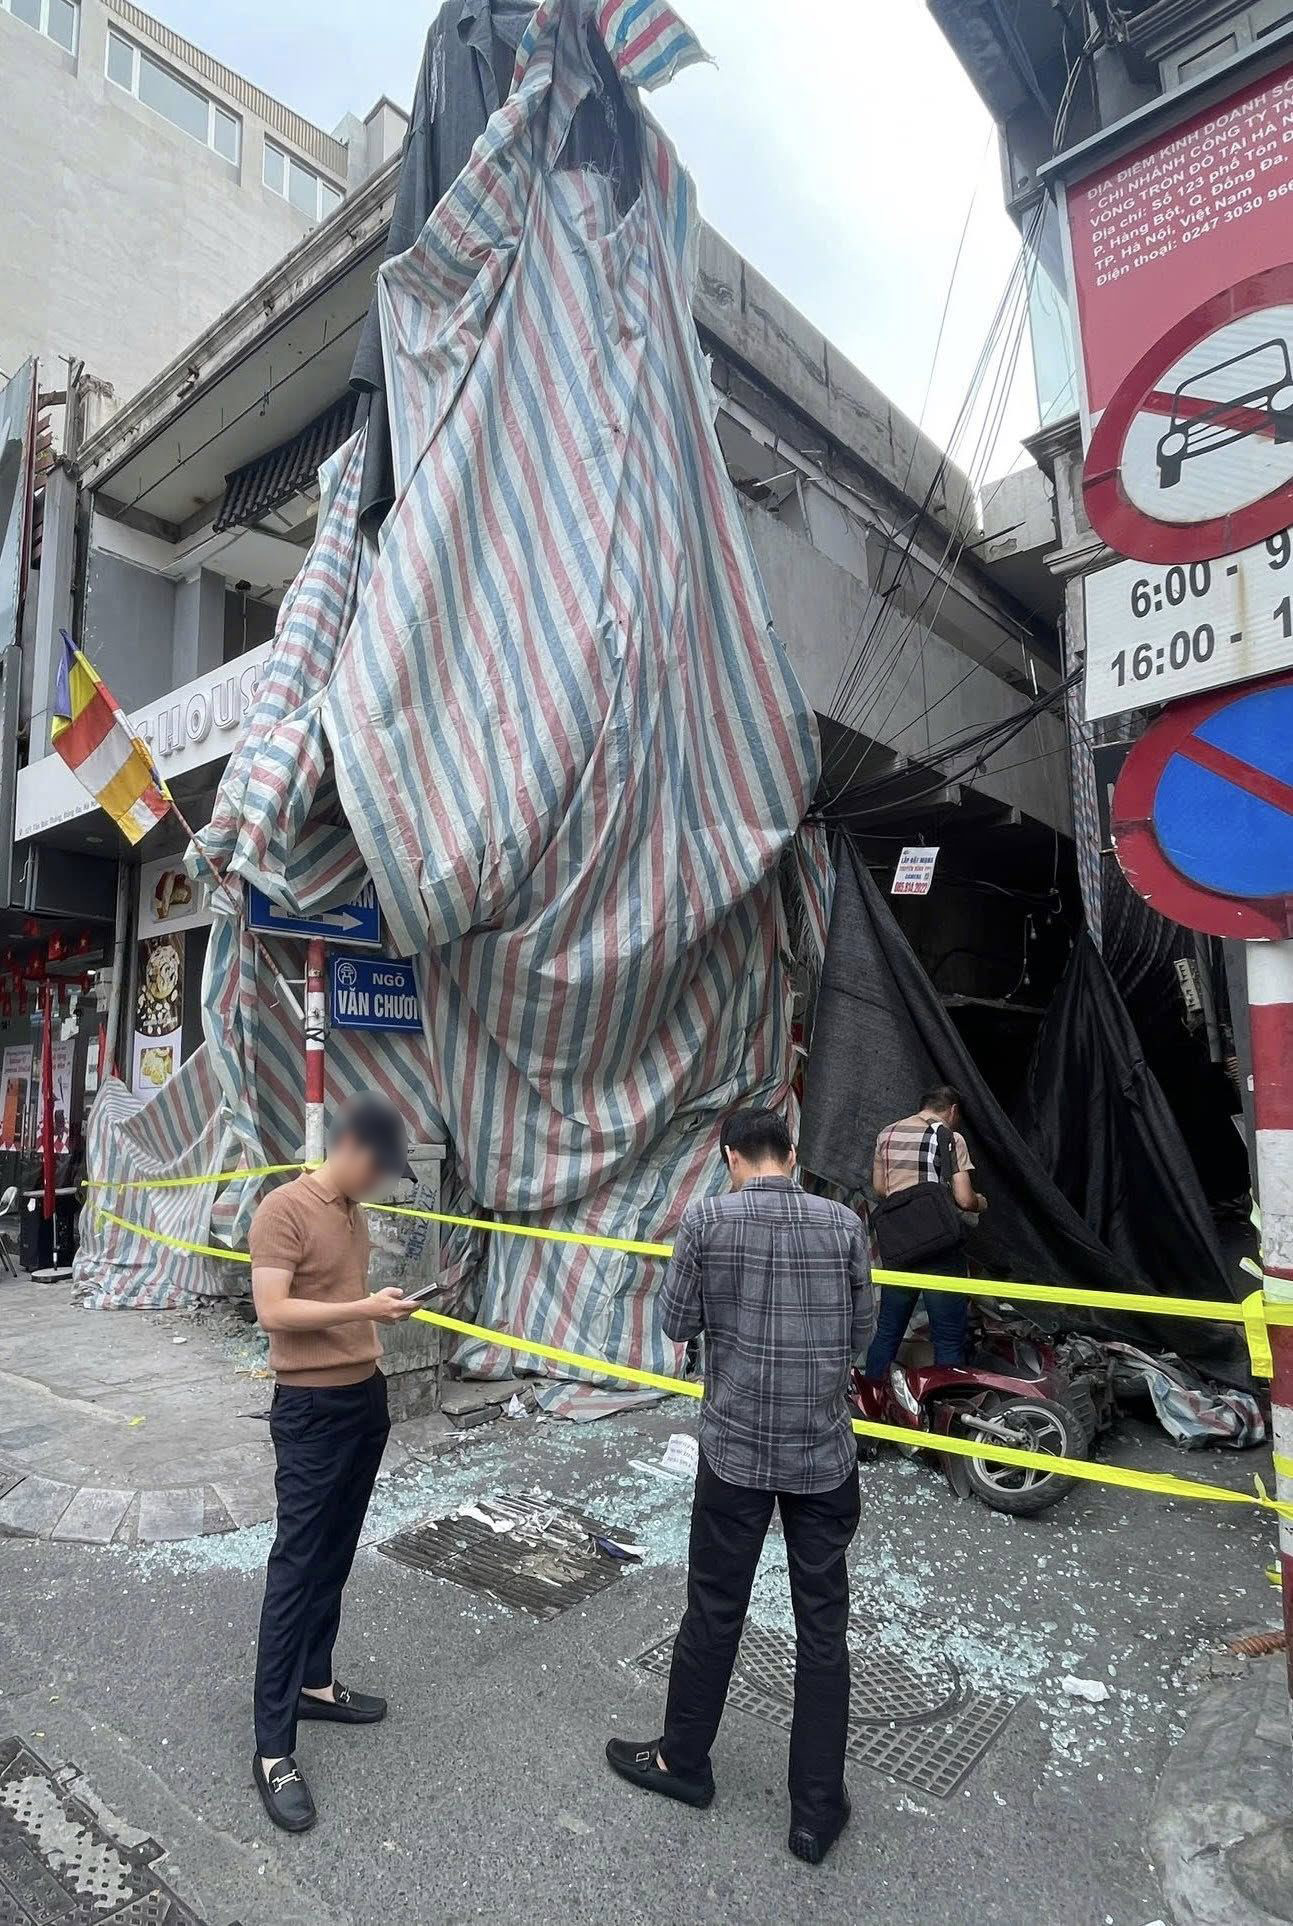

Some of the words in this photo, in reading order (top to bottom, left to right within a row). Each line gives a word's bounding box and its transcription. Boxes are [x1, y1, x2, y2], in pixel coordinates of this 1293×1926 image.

[1087, 179, 1113, 201] ĐỊA
[1161, 130, 1199, 159] KINH
[1204, 95, 1267, 135] DOANH
[1092, 223, 1115, 243] Địa
[1152, 191, 1173, 213] Số
[1177, 178, 1205, 199] 123
[1208, 158, 1241, 184] phố
[1244, 140, 1277, 163] Tôn
[1098, 189, 1124, 210] CHI
[1128, 155, 1185, 193] NHÁNH
[1190, 126, 1240, 158] CÔNG
[1244, 110, 1267, 128] TY
[1139, 170, 1185, 202] TRÒN
[1219, 139, 1247, 161] TẠI
[1251, 123, 1278, 143] HÀ
[1093, 243, 1107, 257] P.
[1110, 222, 1149, 250] Hàng
[1153, 203, 1186, 226] Bột,
[1190, 193, 1207, 208] Q.
[1211, 170, 1256, 197] Đống
[1259, 155, 1289, 172] Đa,
[1094, 255, 1117, 271] TP.
[1121, 240, 1142, 260] Hà
[1145, 223, 1176, 246] Nội,
[1179, 206, 1213, 228] Việt
[1215, 187, 1253, 210] Nam
[1095, 263, 1130, 287] Điện
[1133, 239, 1179, 267] thoại:
[1182, 219, 1220, 245] 0247
[1224, 196, 1264, 223] 3030
[1131, 560, 1211, 618] 6:00
[1226, 564, 1238, 577] -
[1111, 623, 1215, 687] 16:00
[1230, 632, 1243, 644] -
[158, 662, 267, 756] HOUS
[337, 986, 370, 1016] VĂN
[372, 972, 405, 988] NGÕ
